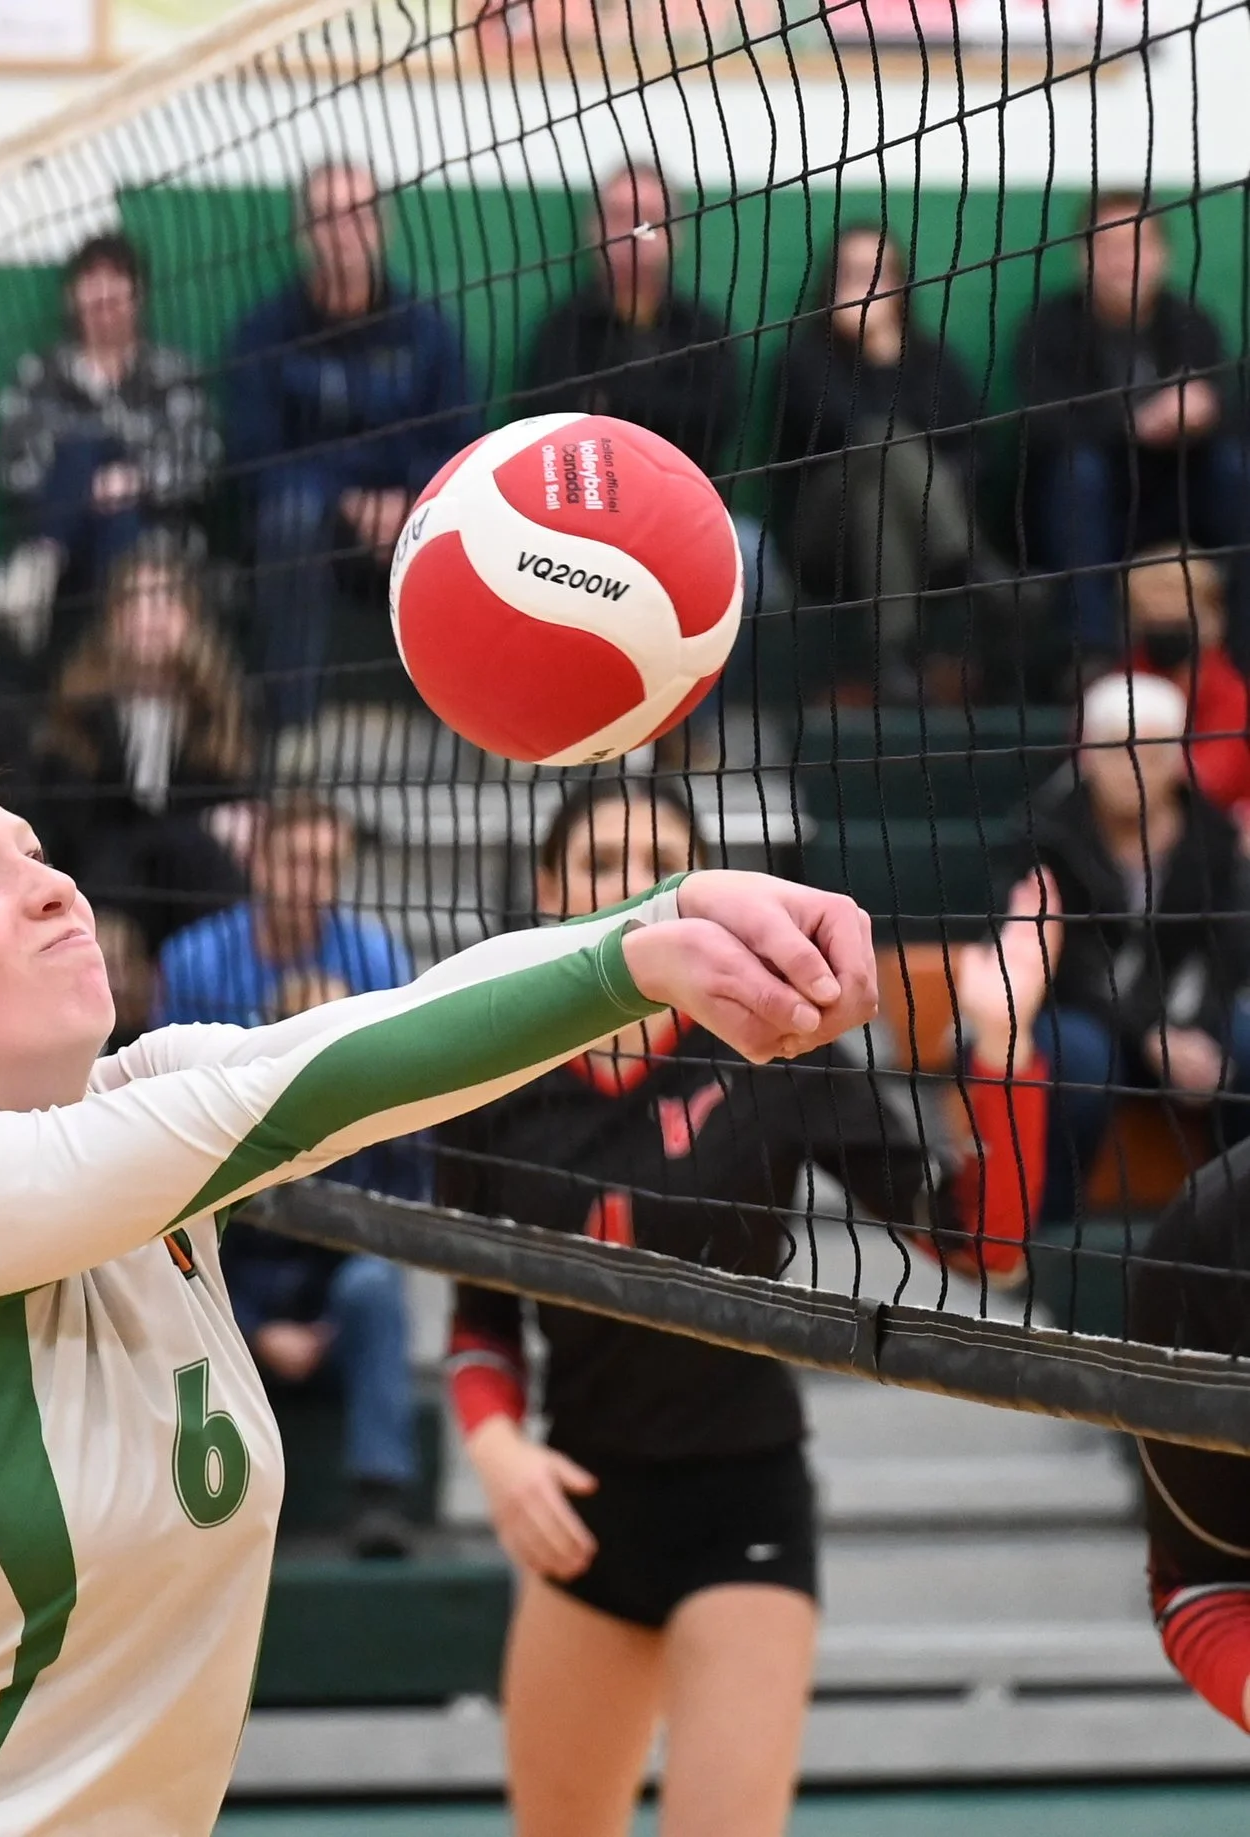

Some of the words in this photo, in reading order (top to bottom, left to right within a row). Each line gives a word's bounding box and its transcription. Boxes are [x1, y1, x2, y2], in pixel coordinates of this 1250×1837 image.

[545, 483, 561, 511] Ball
[561, 443, 582, 504] Canada
[578, 439, 604, 510] Volleyball
[517, 551, 631, 602] VQ200W
[172, 1357, 250, 1530] 6
